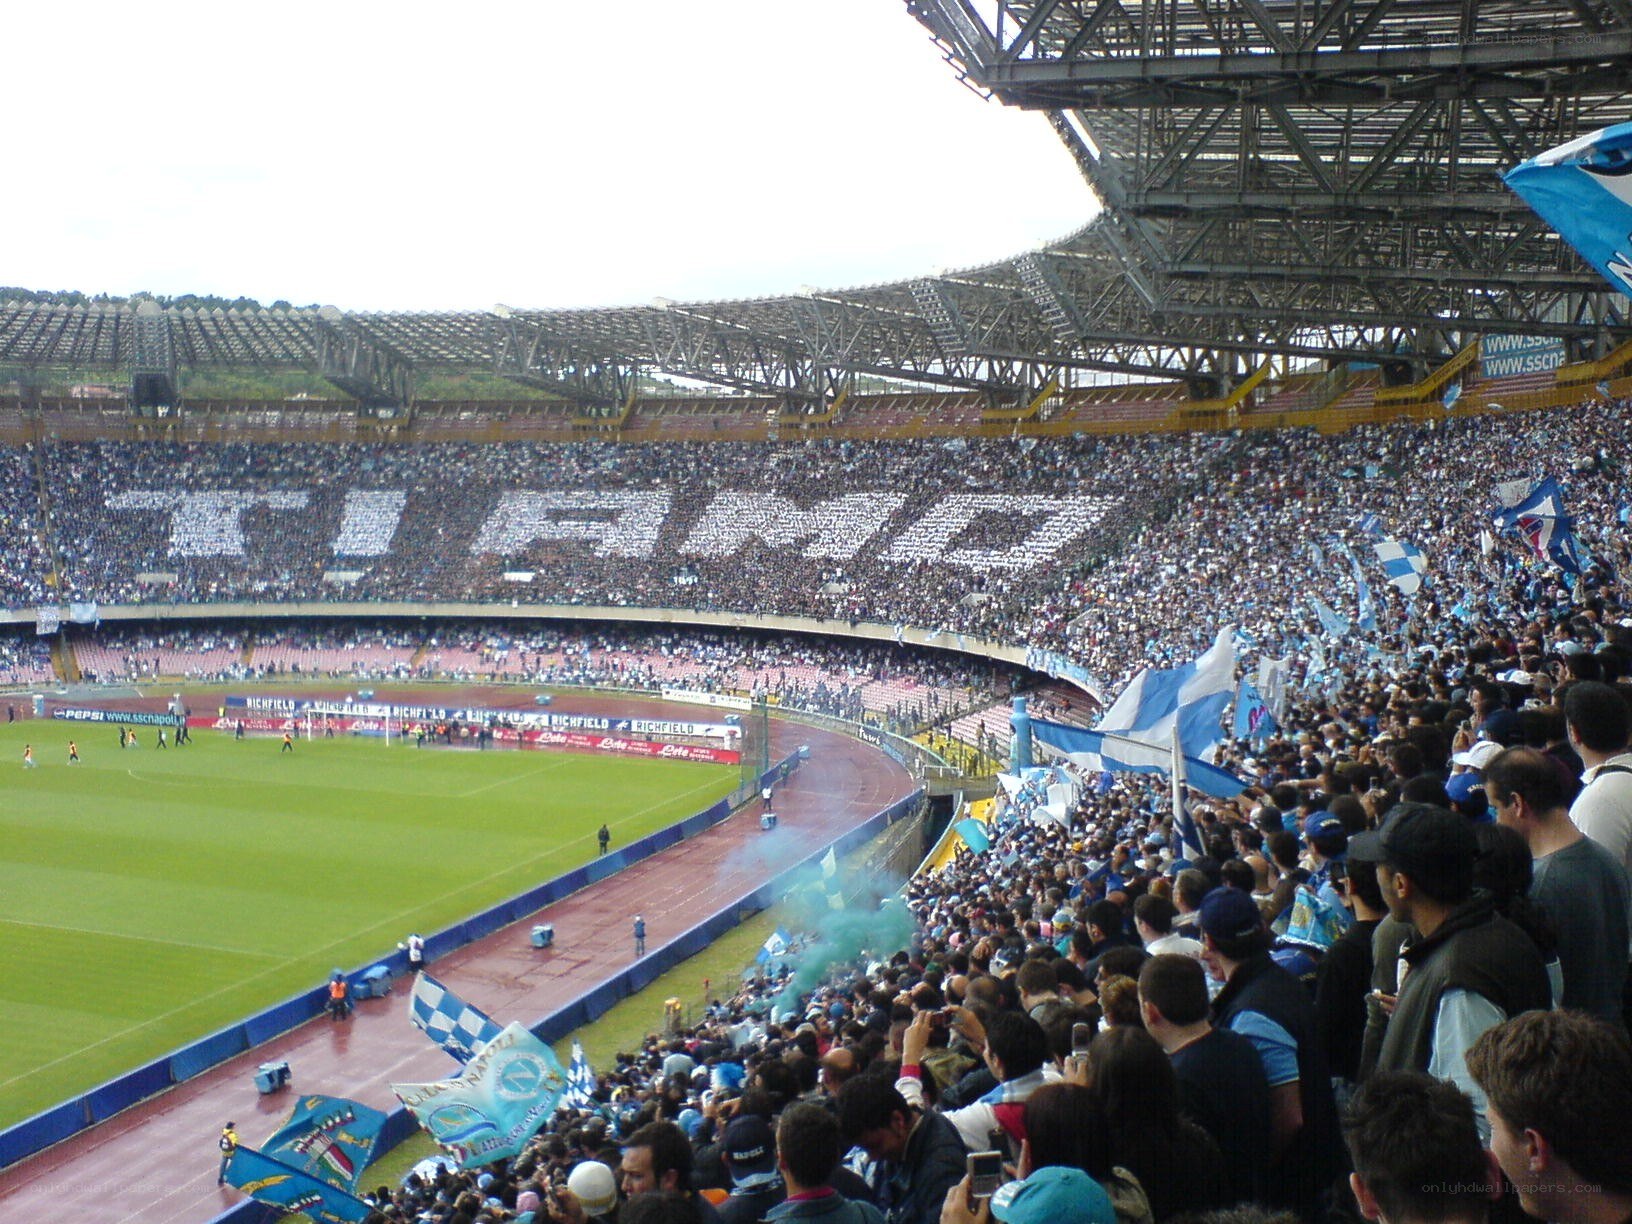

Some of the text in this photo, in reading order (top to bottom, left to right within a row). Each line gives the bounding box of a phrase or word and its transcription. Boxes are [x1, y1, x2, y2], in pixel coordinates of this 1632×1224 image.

[468, 487, 1125, 570] AMO
[65, 708, 104, 720] PEPSI
[551, 714, 609, 729] RICHFIELD
[637, 721, 694, 734] RICHFIELD
